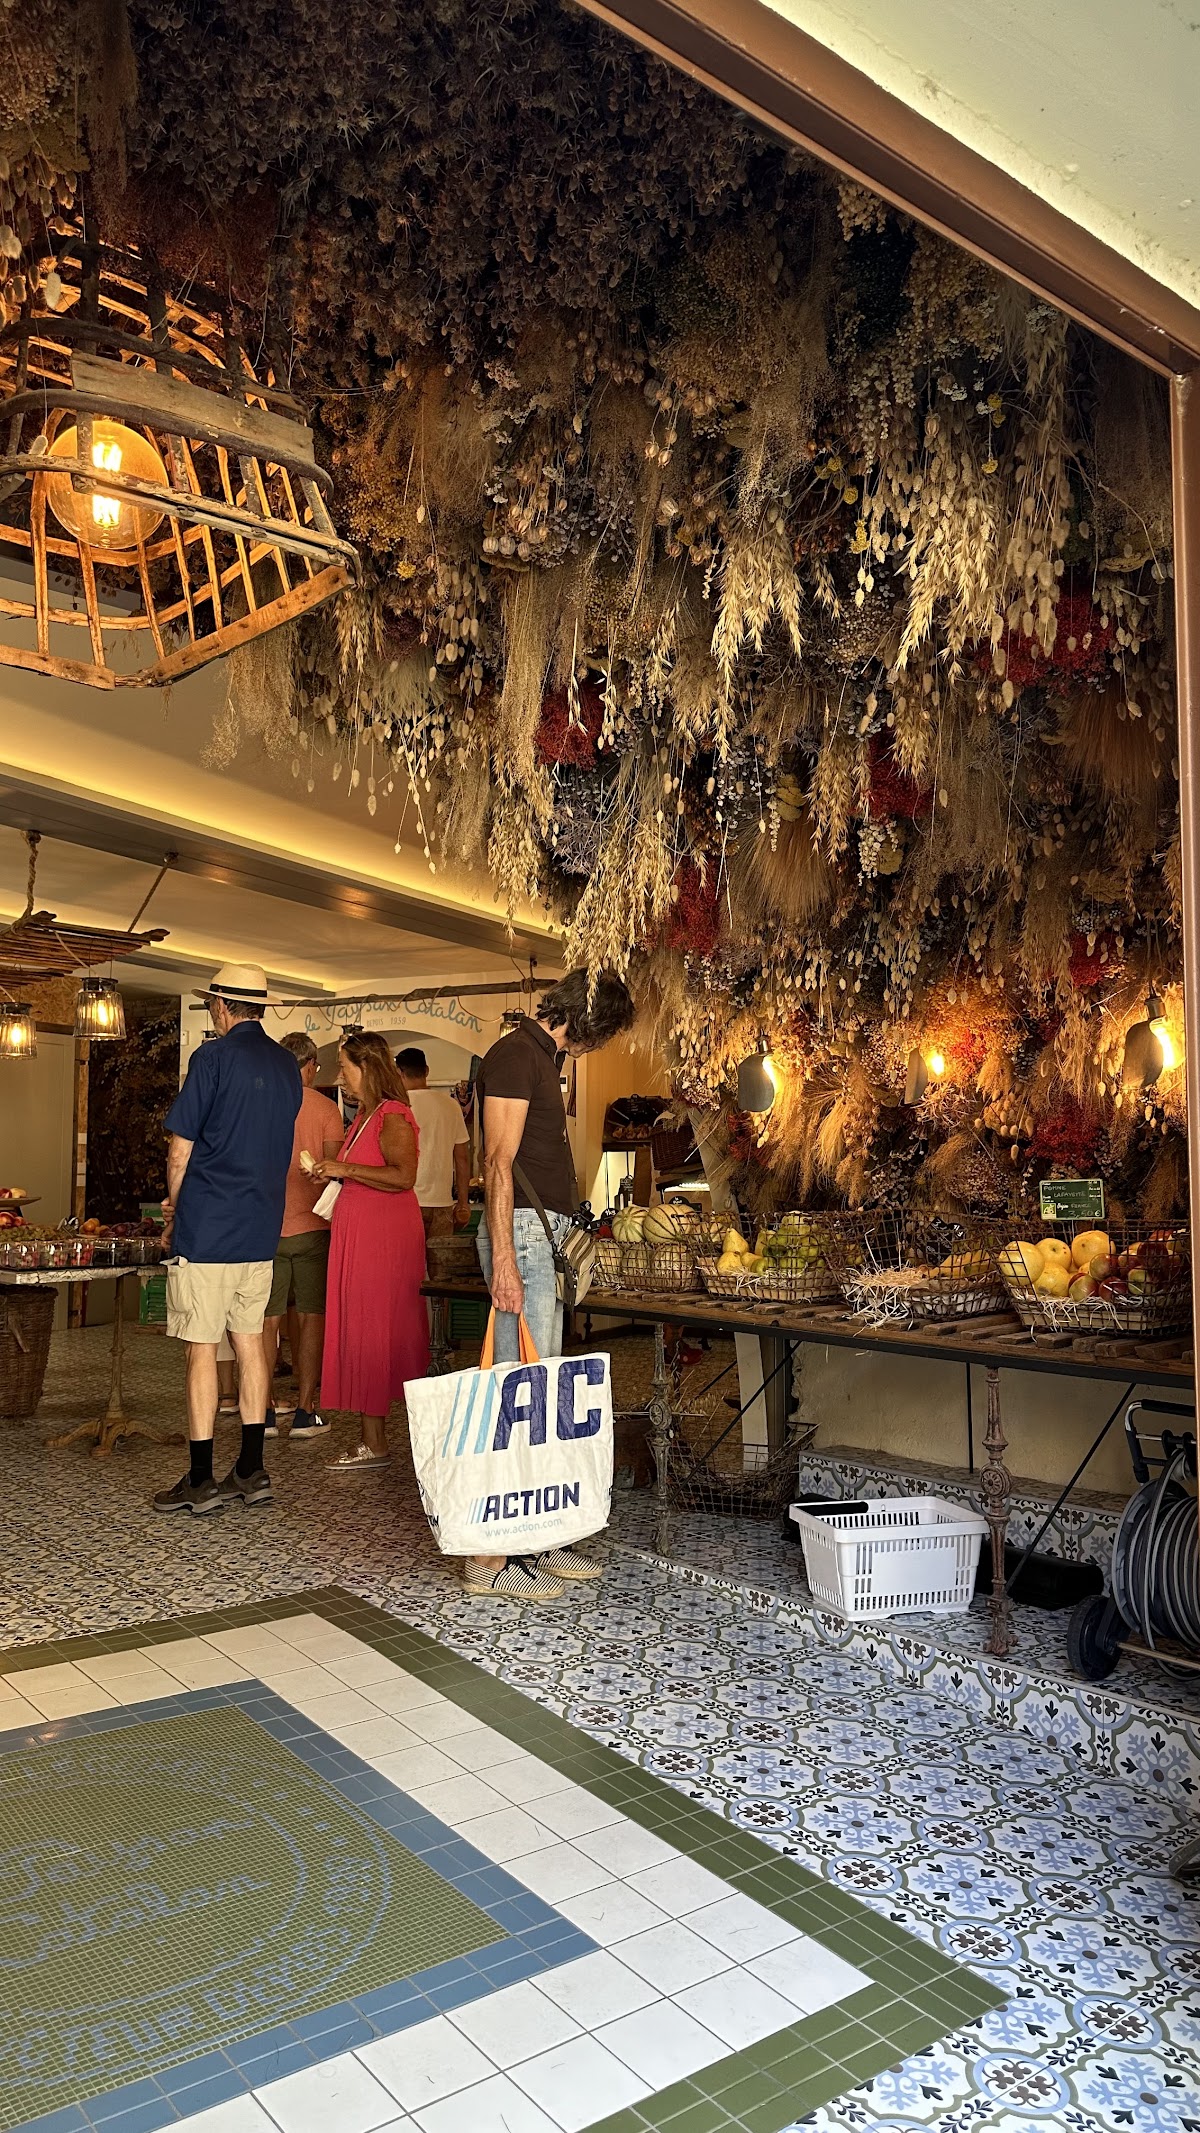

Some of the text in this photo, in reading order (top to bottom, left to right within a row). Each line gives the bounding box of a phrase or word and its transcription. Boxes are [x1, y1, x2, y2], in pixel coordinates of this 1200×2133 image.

[305, 1013, 320, 1034] le
[404, 998, 483, 1033] Catalan
[366, 1016, 406, 1028] DEPUIS 1959
[492, 1358, 605, 1452] AC
[482, 1482, 580, 1523] ACTION
[484, 1516, 563, 1538] www.action.com
